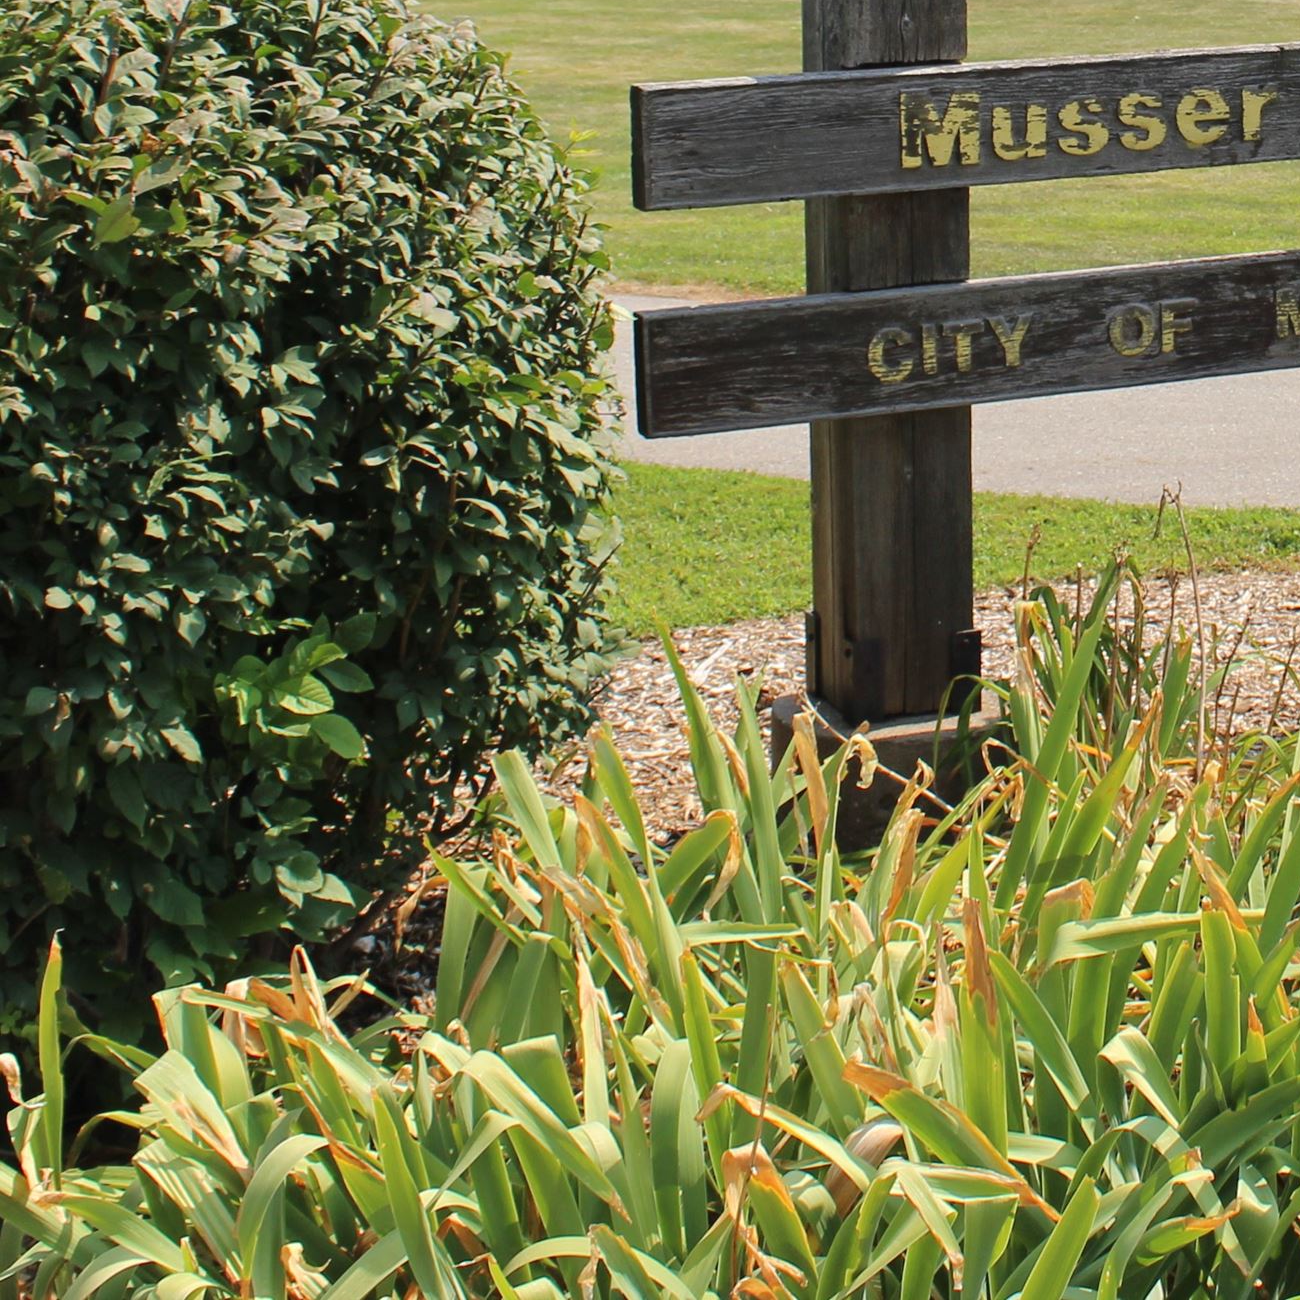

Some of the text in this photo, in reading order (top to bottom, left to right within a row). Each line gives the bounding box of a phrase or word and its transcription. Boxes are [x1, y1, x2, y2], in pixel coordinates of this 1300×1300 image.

[899, 86, 1278, 169] Musser
[867, 311, 1034, 384] CITY
[1108, 298, 1197, 357] OF
